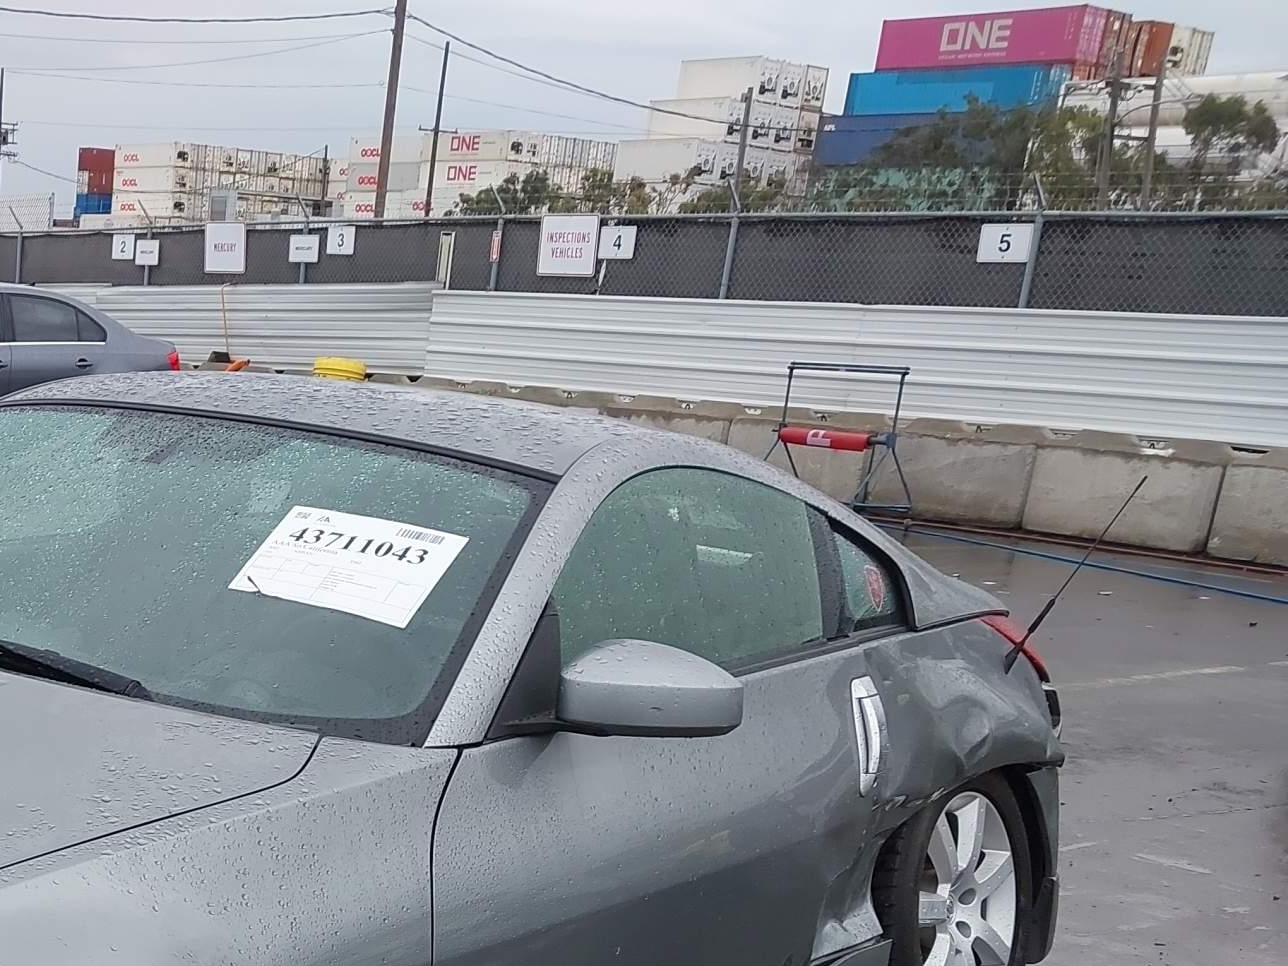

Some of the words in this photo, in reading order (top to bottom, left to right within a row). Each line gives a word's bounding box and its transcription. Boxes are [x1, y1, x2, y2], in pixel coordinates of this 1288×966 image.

[939, 19, 1013, 51] ONE
[450, 135, 480, 151] ONE
[447, 165, 477, 181] ONE
[337, 233, 345, 247] 3
[546, 231, 590, 244] INSPECTIONS
[613, 234, 622, 250] 4
[998, 233, 1012, 253] 5
[120, 240, 126, 253] 2
[213, 242, 237, 252] MERCURY
[551, 247, 583, 259] VEHICLES
[289, 527, 429, 565] 43711043
